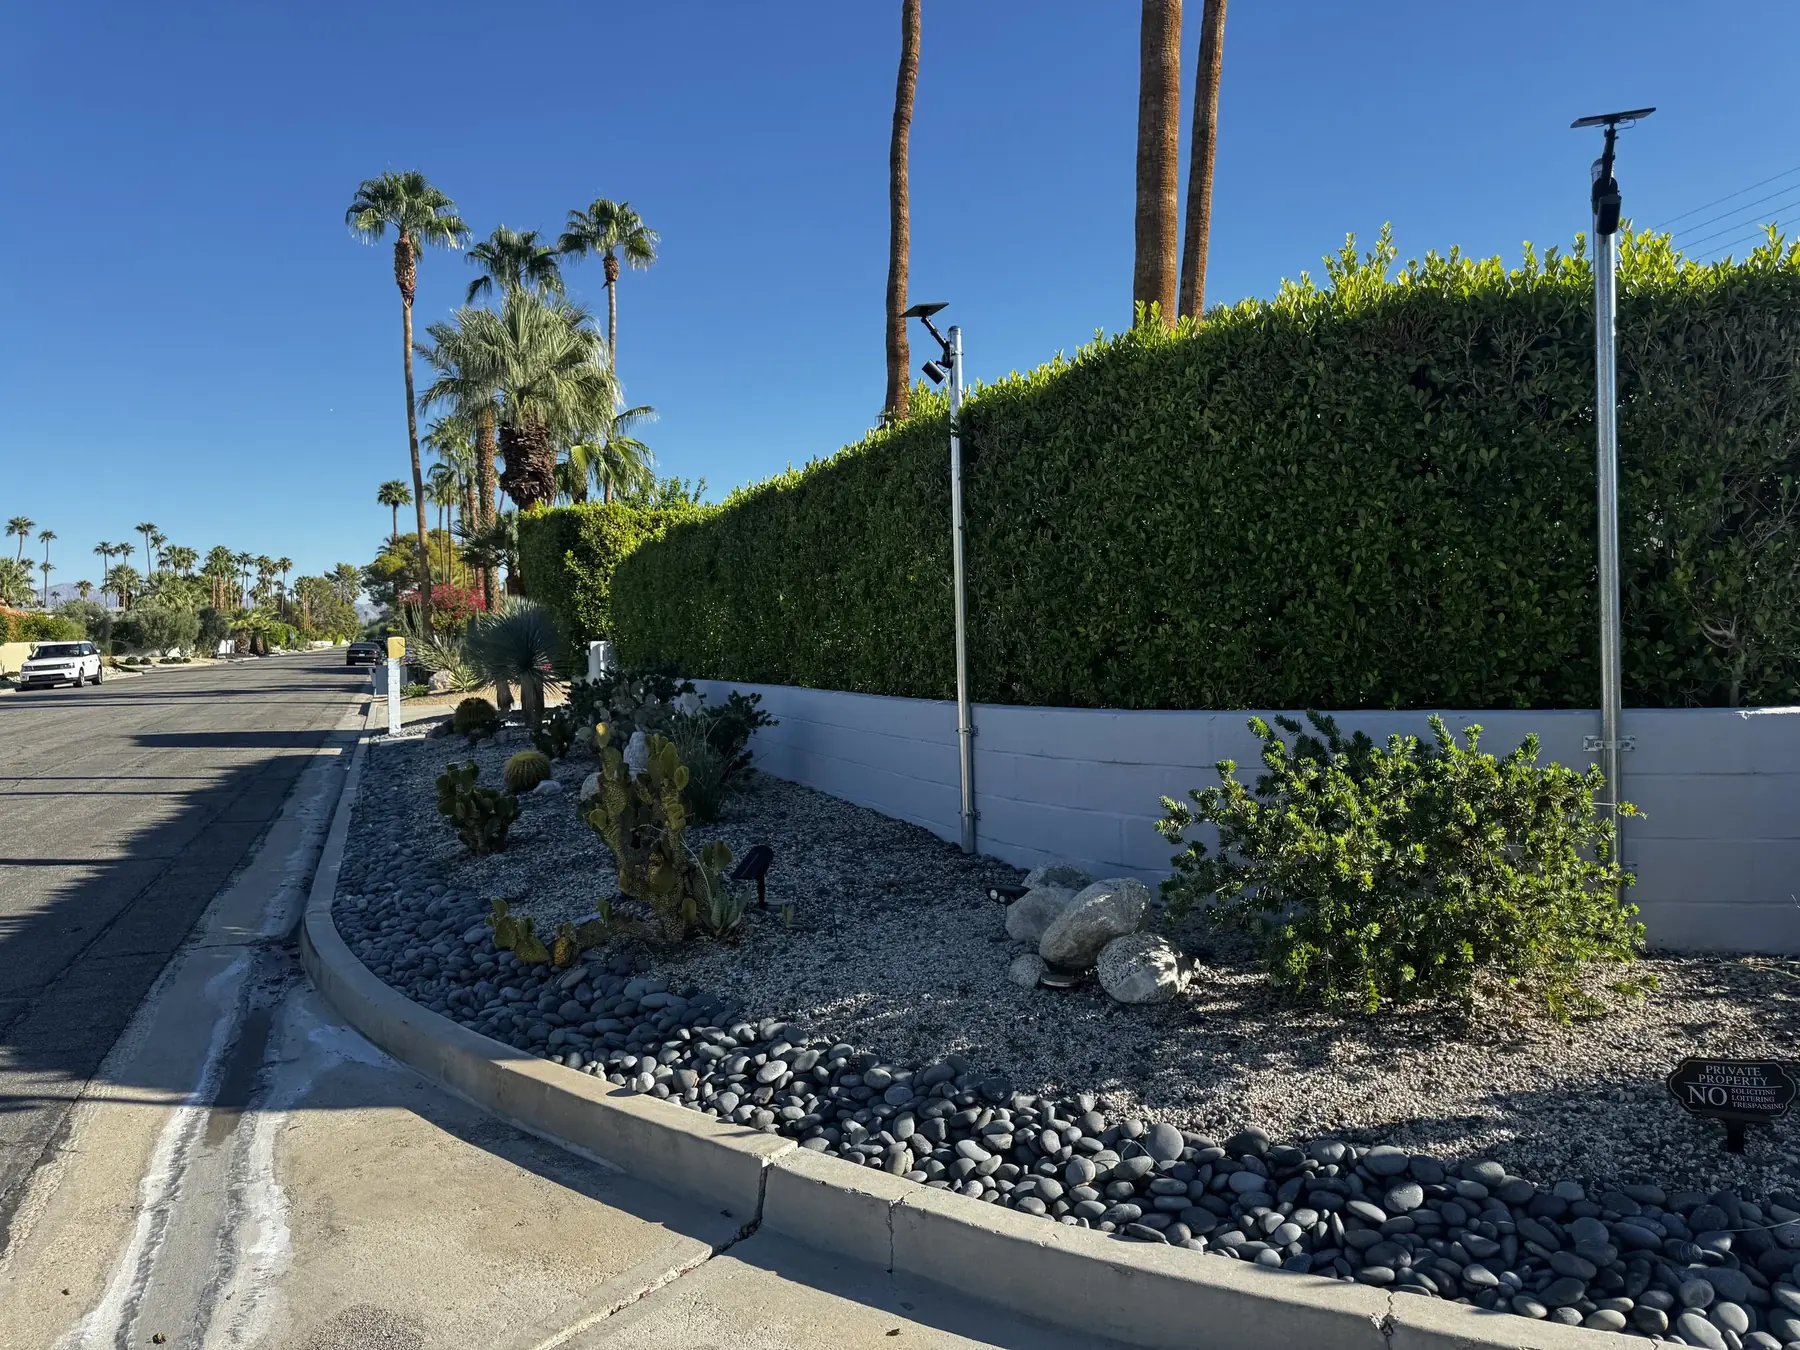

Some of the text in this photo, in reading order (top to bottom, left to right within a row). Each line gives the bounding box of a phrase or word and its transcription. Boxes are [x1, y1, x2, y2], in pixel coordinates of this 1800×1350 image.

[1706, 1065, 1761, 1076] PRIVATE
[1698, 1074, 1767, 1085] PROPERTY
[1688, 1085, 1727, 1106] NO
[1731, 1088, 1775, 1096] SOLICITING
[1732, 1094, 1774, 1102] LOITERING
[1732, 1101, 1784, 1109] TRESPASSING
